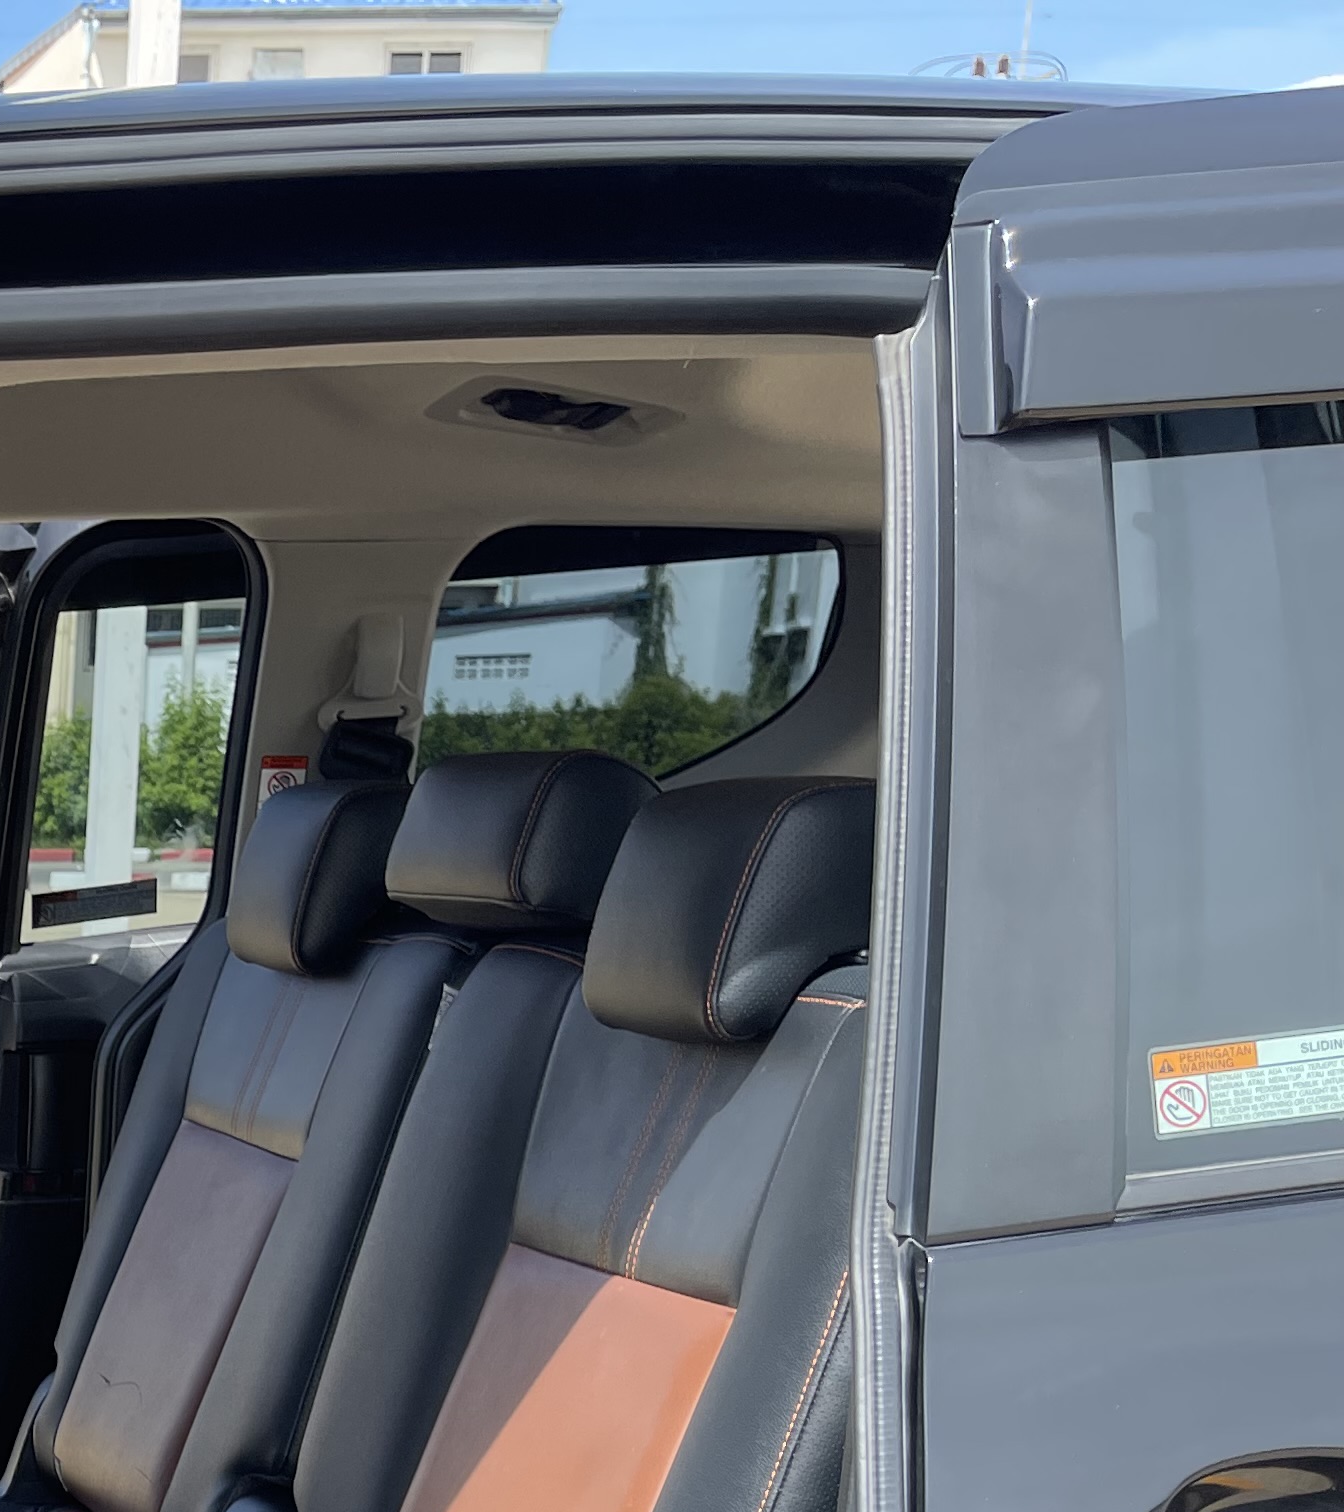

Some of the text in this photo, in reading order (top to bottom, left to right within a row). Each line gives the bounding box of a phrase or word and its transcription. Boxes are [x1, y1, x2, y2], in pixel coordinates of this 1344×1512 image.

[1179, 1045, 1252, 1062] PERINGATAN
[1300, 1038, 1344, 1054] SLIDIN
[1179, 1058, 1234, 1073] WARNING
[1272, 1092, 1281, 1100] TO
[1294, 1098, 1305, 1106] OR
